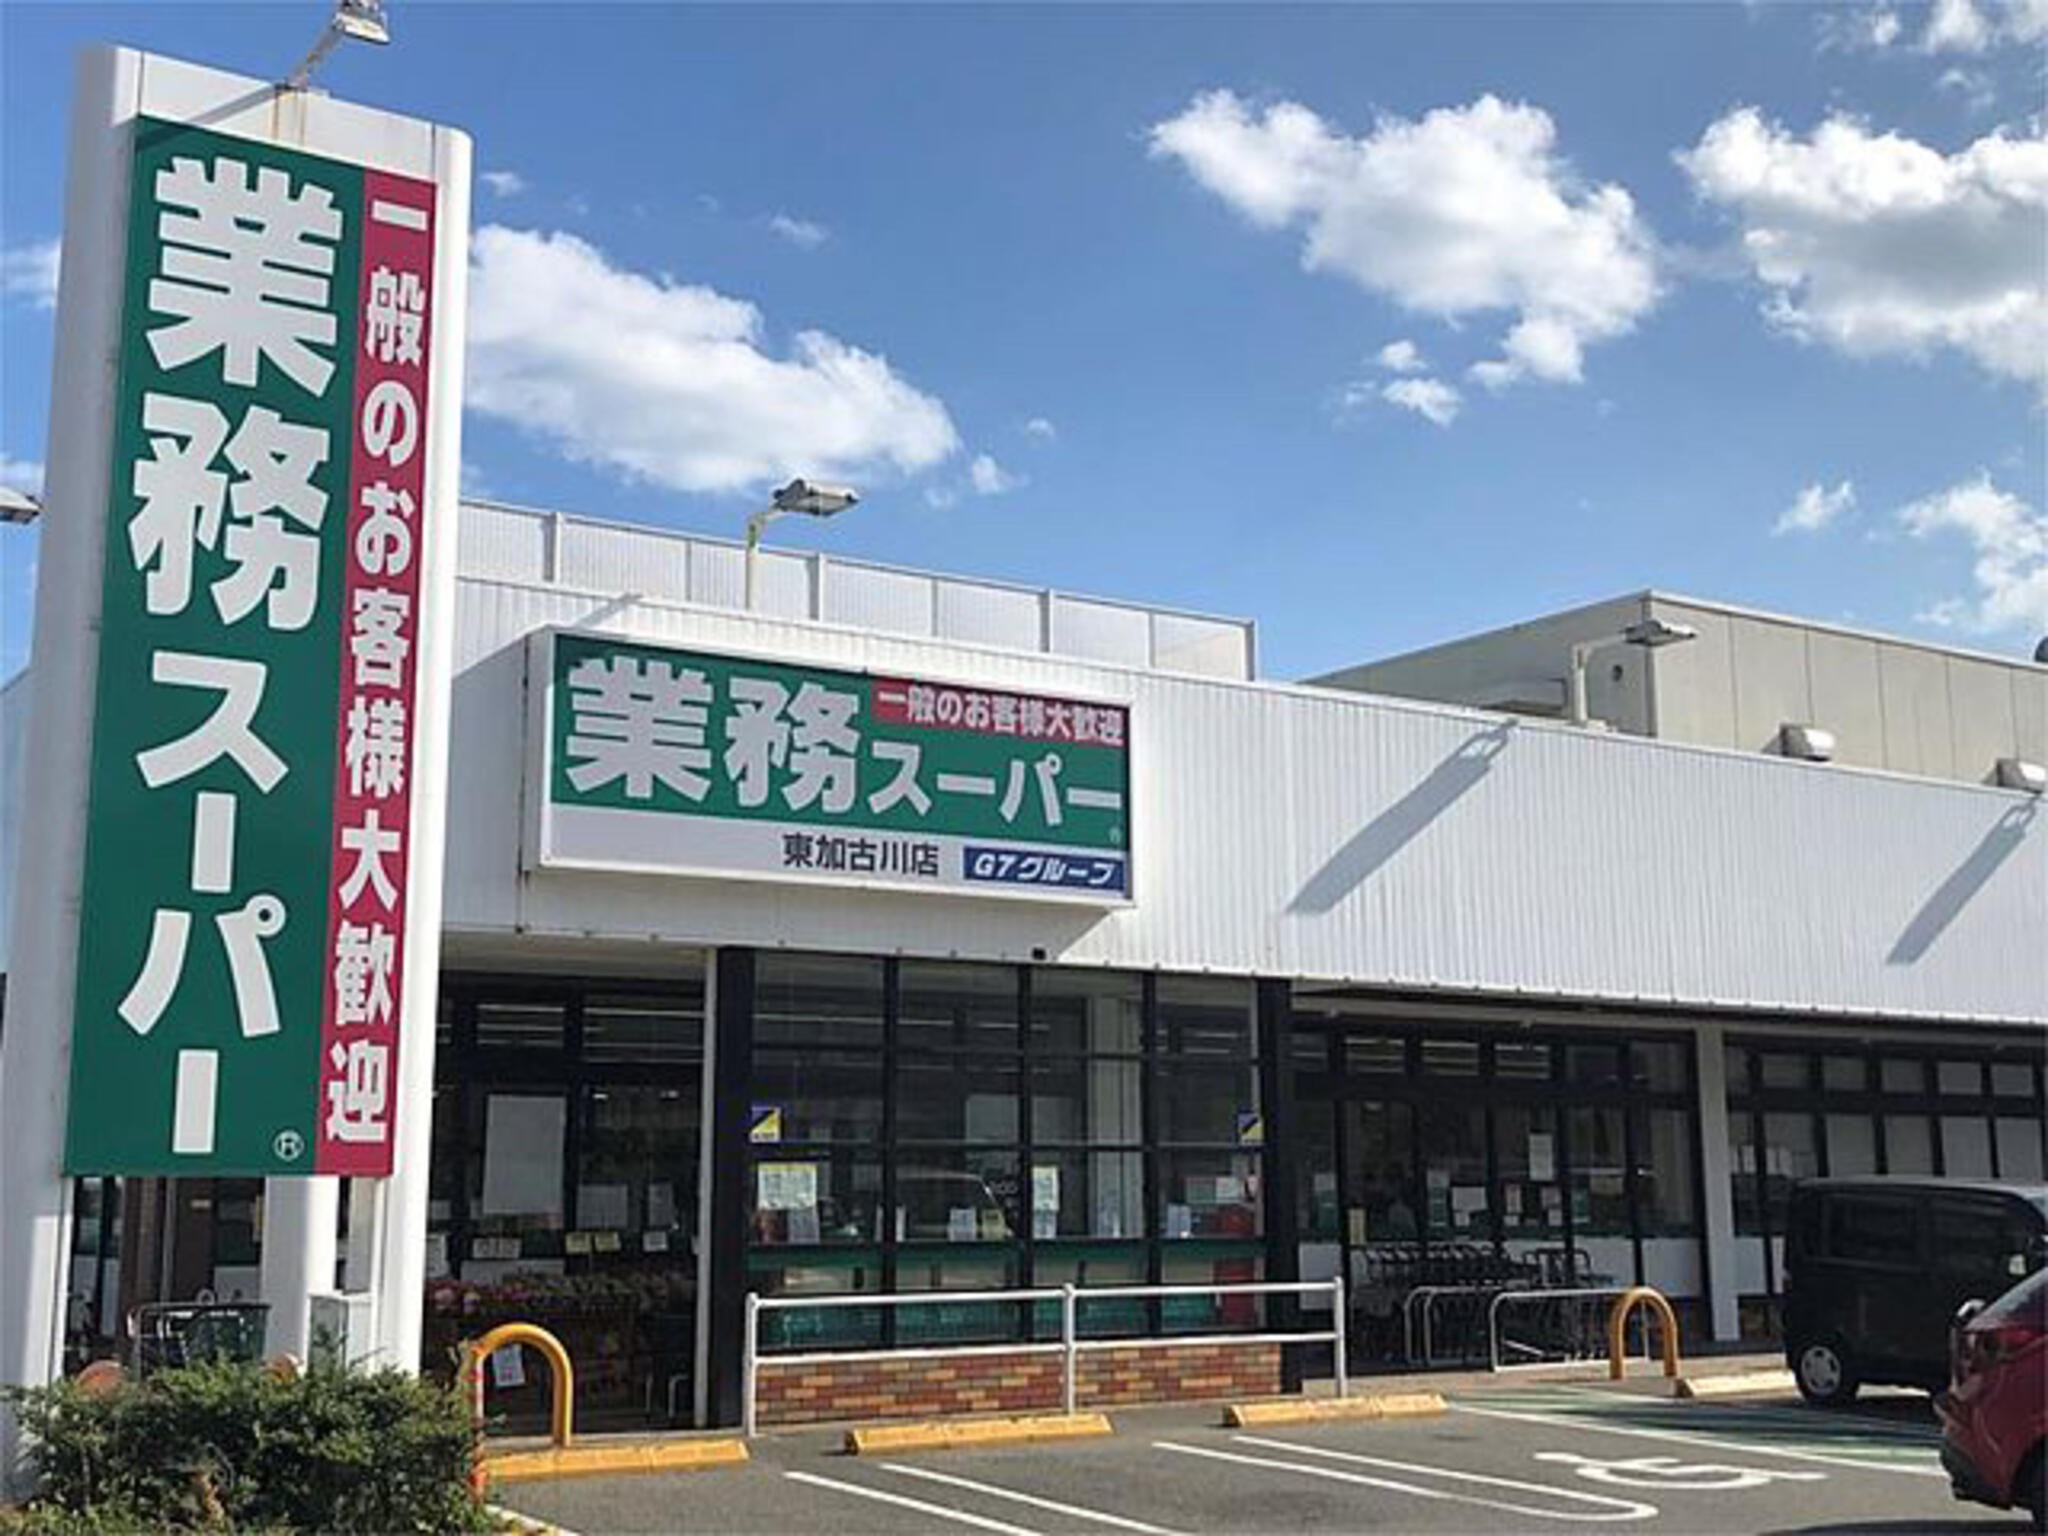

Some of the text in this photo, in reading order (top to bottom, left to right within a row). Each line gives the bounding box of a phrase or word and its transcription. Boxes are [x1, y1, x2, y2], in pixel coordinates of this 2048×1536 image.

[117, 156, 344, 1153] 業務スーパー
[325, 199, 428, 1143] 一般のお客様大歓迎
[879, 686, 1124, 745] 一般のお客様大歓迎
[565, 656, 1122, 827] 業務スーパー
[782, 832, 939, 877] 東加古川店
